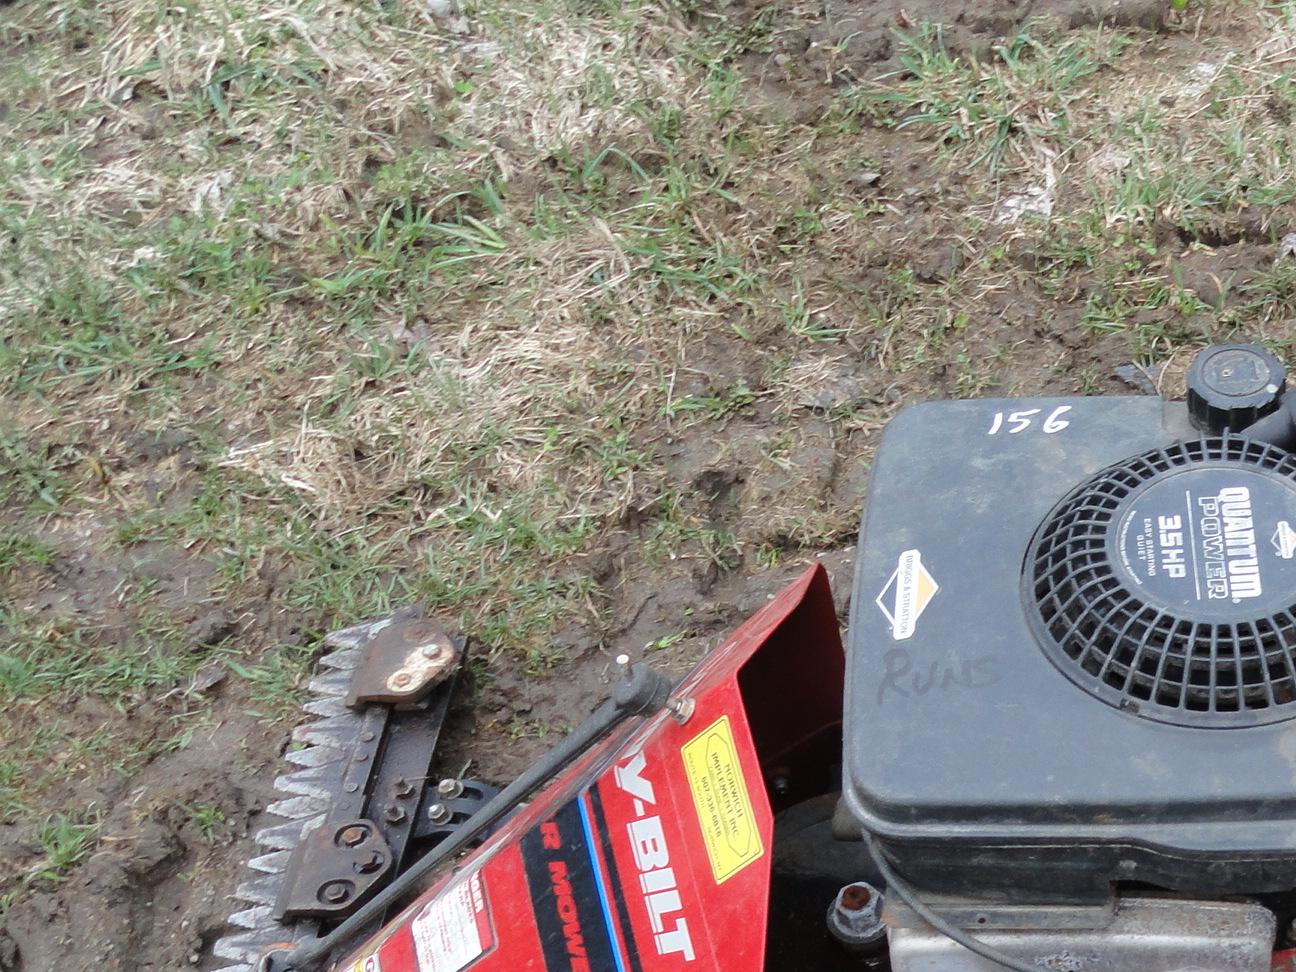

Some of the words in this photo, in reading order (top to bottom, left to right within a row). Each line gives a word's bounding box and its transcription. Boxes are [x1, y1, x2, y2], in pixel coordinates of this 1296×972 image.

[988, 405, 1073, 434] 156
[1137, 534, 1146, 560] QUIET
[1144, 518, 1152, 538] EASY
[1217, 486, 1262, 598] QUANTUM
[1146, 540, 1156, 577] STARTING
[1199, 496, 1228, 600] POWER
[903, 554, 913, 585] BRIGGS
[900, 592, 910, 634] STRATTON
[711, 752, 733, 815] IMPLEMENT
[724, 763, 744, 818] NORWICH
